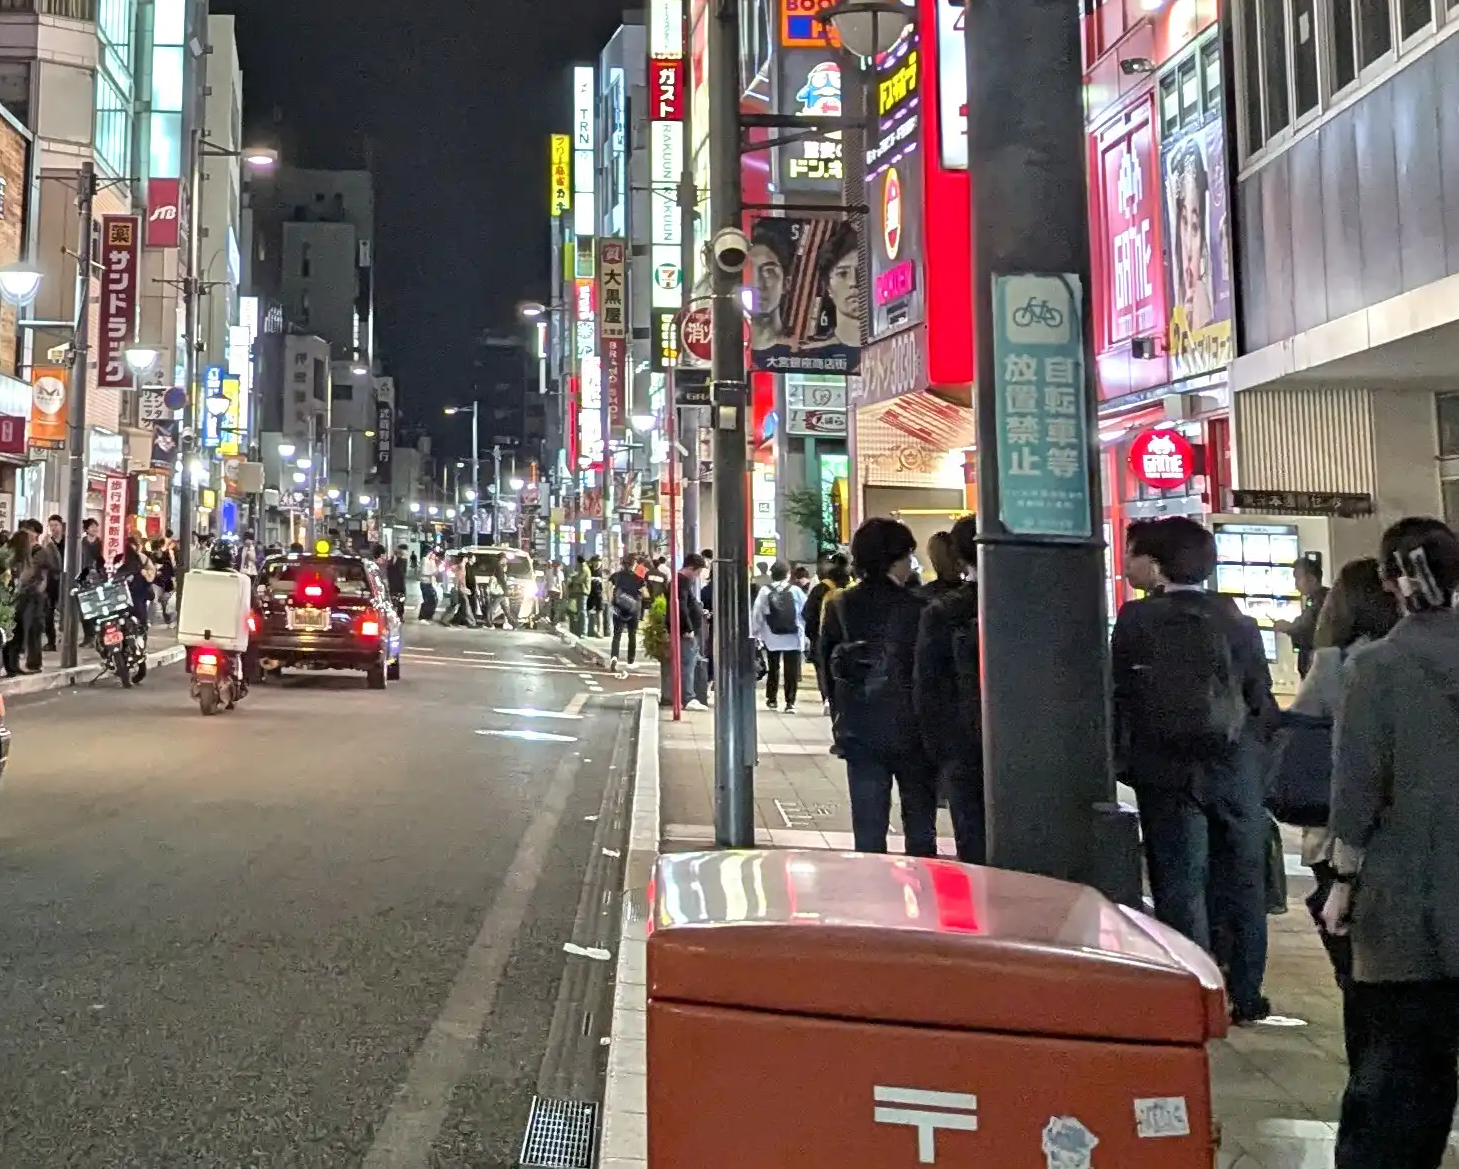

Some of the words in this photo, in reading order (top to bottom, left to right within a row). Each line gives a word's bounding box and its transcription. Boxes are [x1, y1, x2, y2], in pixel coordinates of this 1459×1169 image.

[658, 68, 675, 118] ガスト
[662, 124, 673, 179] RAKUUN
[150, 206, 177, 221] JTB
[604, 269, 622, 324] 大黒屋
[1004, 353, 1041, 477] 放置禁止
[1044, 356, 1080, 479] 自転車等
[1143, 454, 1184, 473] GAME
